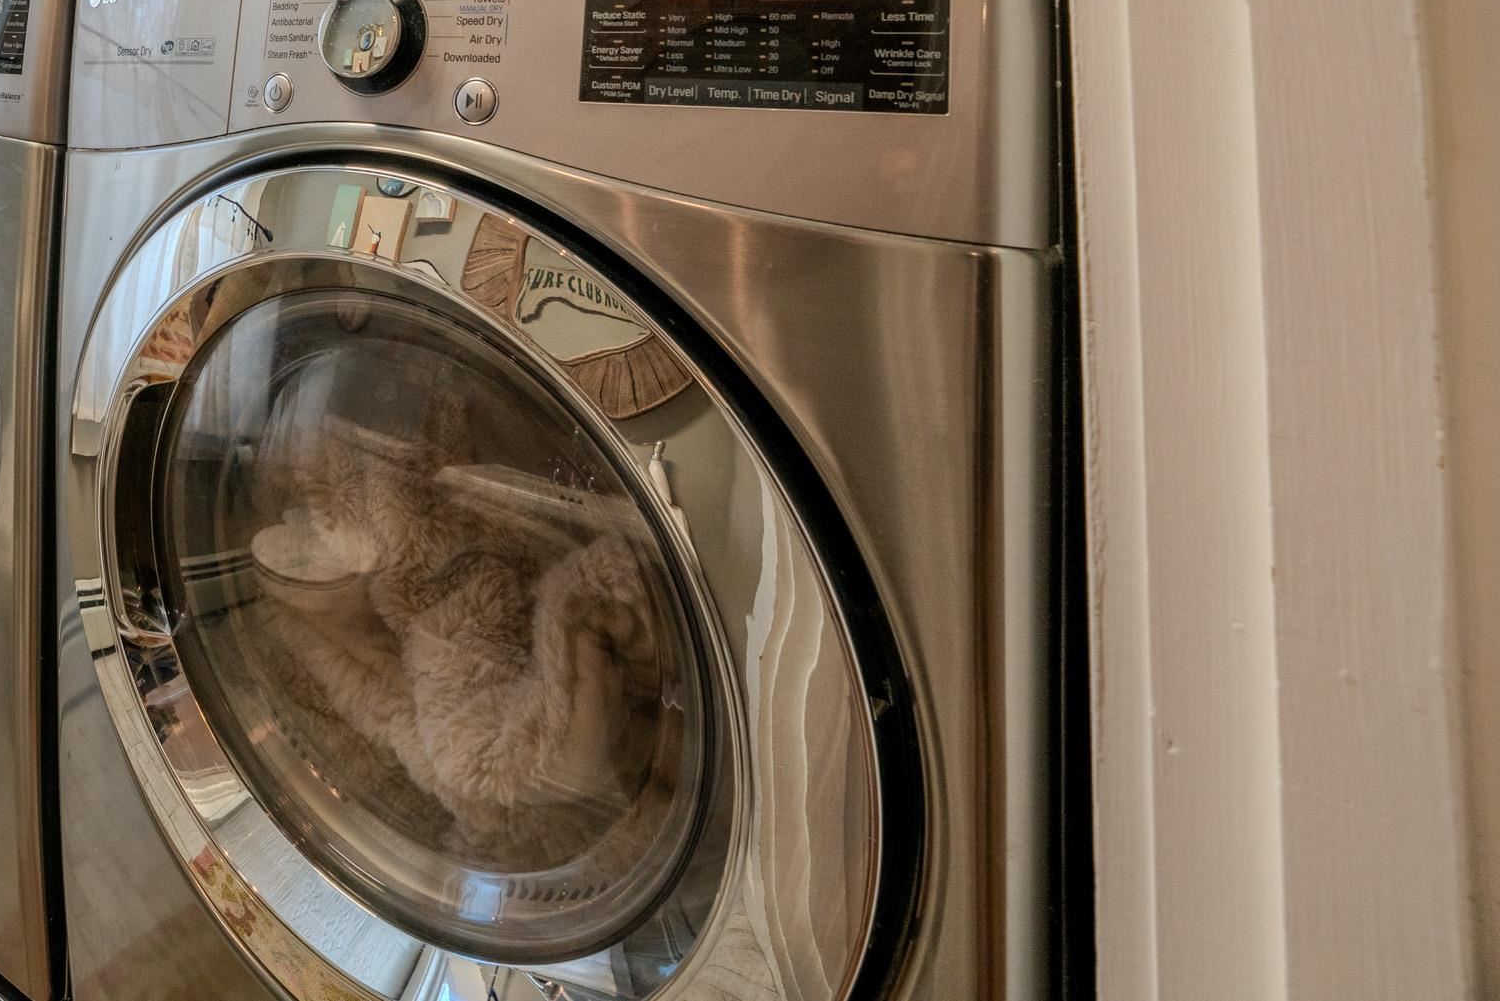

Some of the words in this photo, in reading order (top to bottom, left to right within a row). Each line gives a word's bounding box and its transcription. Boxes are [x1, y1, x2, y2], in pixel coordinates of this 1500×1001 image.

[272, 2, 298, 12] Bedding
[592, 11, 620, 20] Reduce
[622, 11, 646, 19] Static
[668, 14, 686, 23] Very
[715, 14, 733, 22] High
[768, 13, 779, 21] 60
[820, 12, 854, 20] Remote
[881, 12, 906, 21] Less
[908, 12, 935, 21] Time
[270, 17, 314, 26] Antibacterial
[456, 15, 485, 27] Speed
[486, 16, 504, 28] Dry
[714, 26, 729, 34] Mid
[731, 26, 748, 35] High
[768, 26, 779, 34] 50
[269, 33, 288, 43] Steam
[469, 34, 483, 44] Air
[485, 34, 502, 46] Dry
[666, 39, 694, 47] Normal
[714, 39, 746, 47] Medium
[820, 40, 841, 48] High
[117, 46, 139, 57] Sensor
[140, 46, 152, 58] Dry
[267, 50, 288, 59] Steam
[591, 46, 619, 56] Energy
[874, 48, 914, 59] Wrinkle
[916, 49, 941, 59] Care
[443, 52, 501, 63] Downloaded
[666, 52, 684, 60] Less
[713, 52, 732, 60] Low
[768, 53, 779, 61] 30
[820, 53, 840, 61] Low
[665, 65, 688, 73] Damp
[713, 65, 733, 73] Ultra
[768, 66, 779, 74] 20
[820, 66, 835, 75] Off
[591, 81, 621, 90] Custom
[622, 82, 641, 90] PGM
[648, 85, 667, 98] Dry
[668, 85, 694, 97] Level
[708, 87, 742, 100] Temp.
[754, 89, 780, 100] Time
[782, 89, 802, 103] Dry
[869, 89, 895, 100] Damp
[897, 89, 913, 100] Dry
[915, 90, 945, 101] Signal
[815, 90, 855, 104] Signal
[567, 275, 602, 304] CLUB
